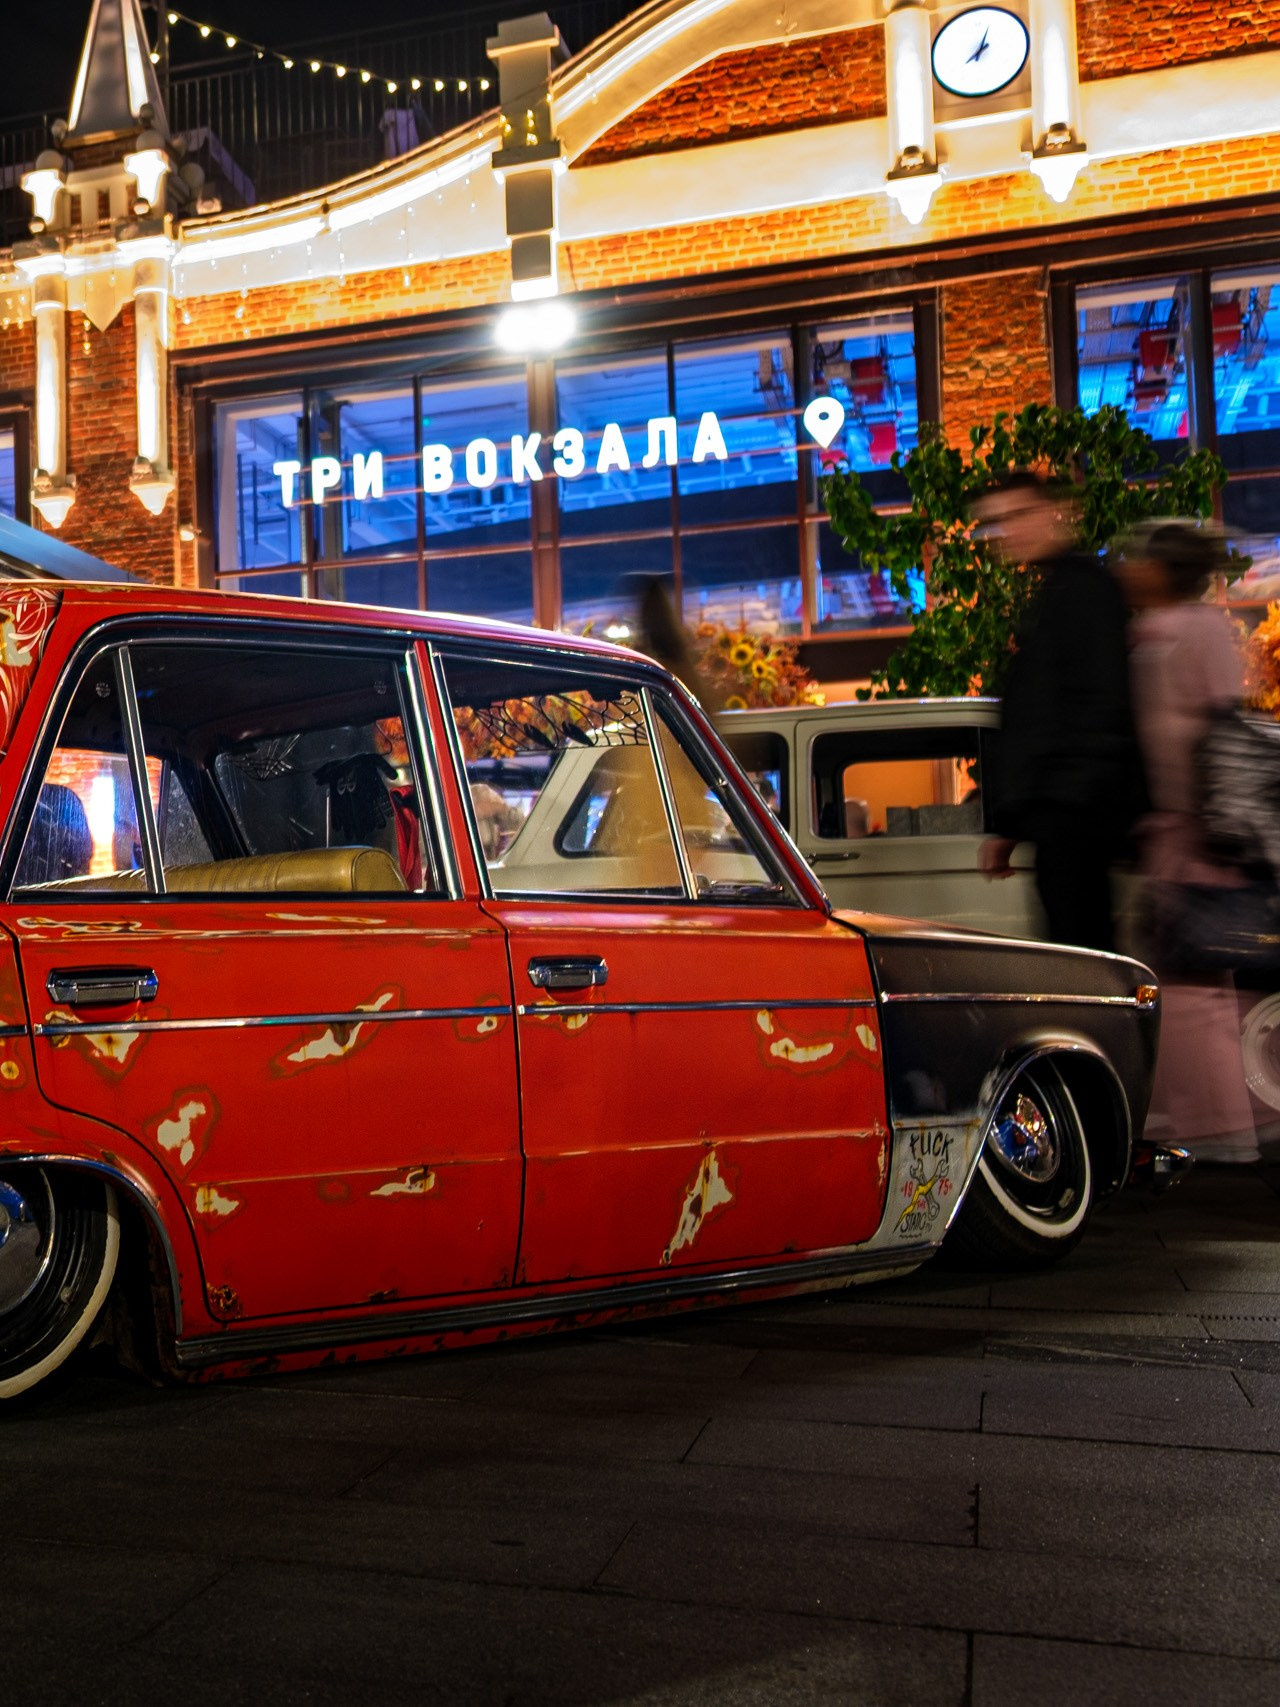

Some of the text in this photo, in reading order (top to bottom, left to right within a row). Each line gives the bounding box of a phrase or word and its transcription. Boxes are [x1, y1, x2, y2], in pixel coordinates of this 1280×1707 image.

[273, 412, 728, 507] ТРИ ВОКЗАЛА
[909, 1131, 954, 1163] FUCK
